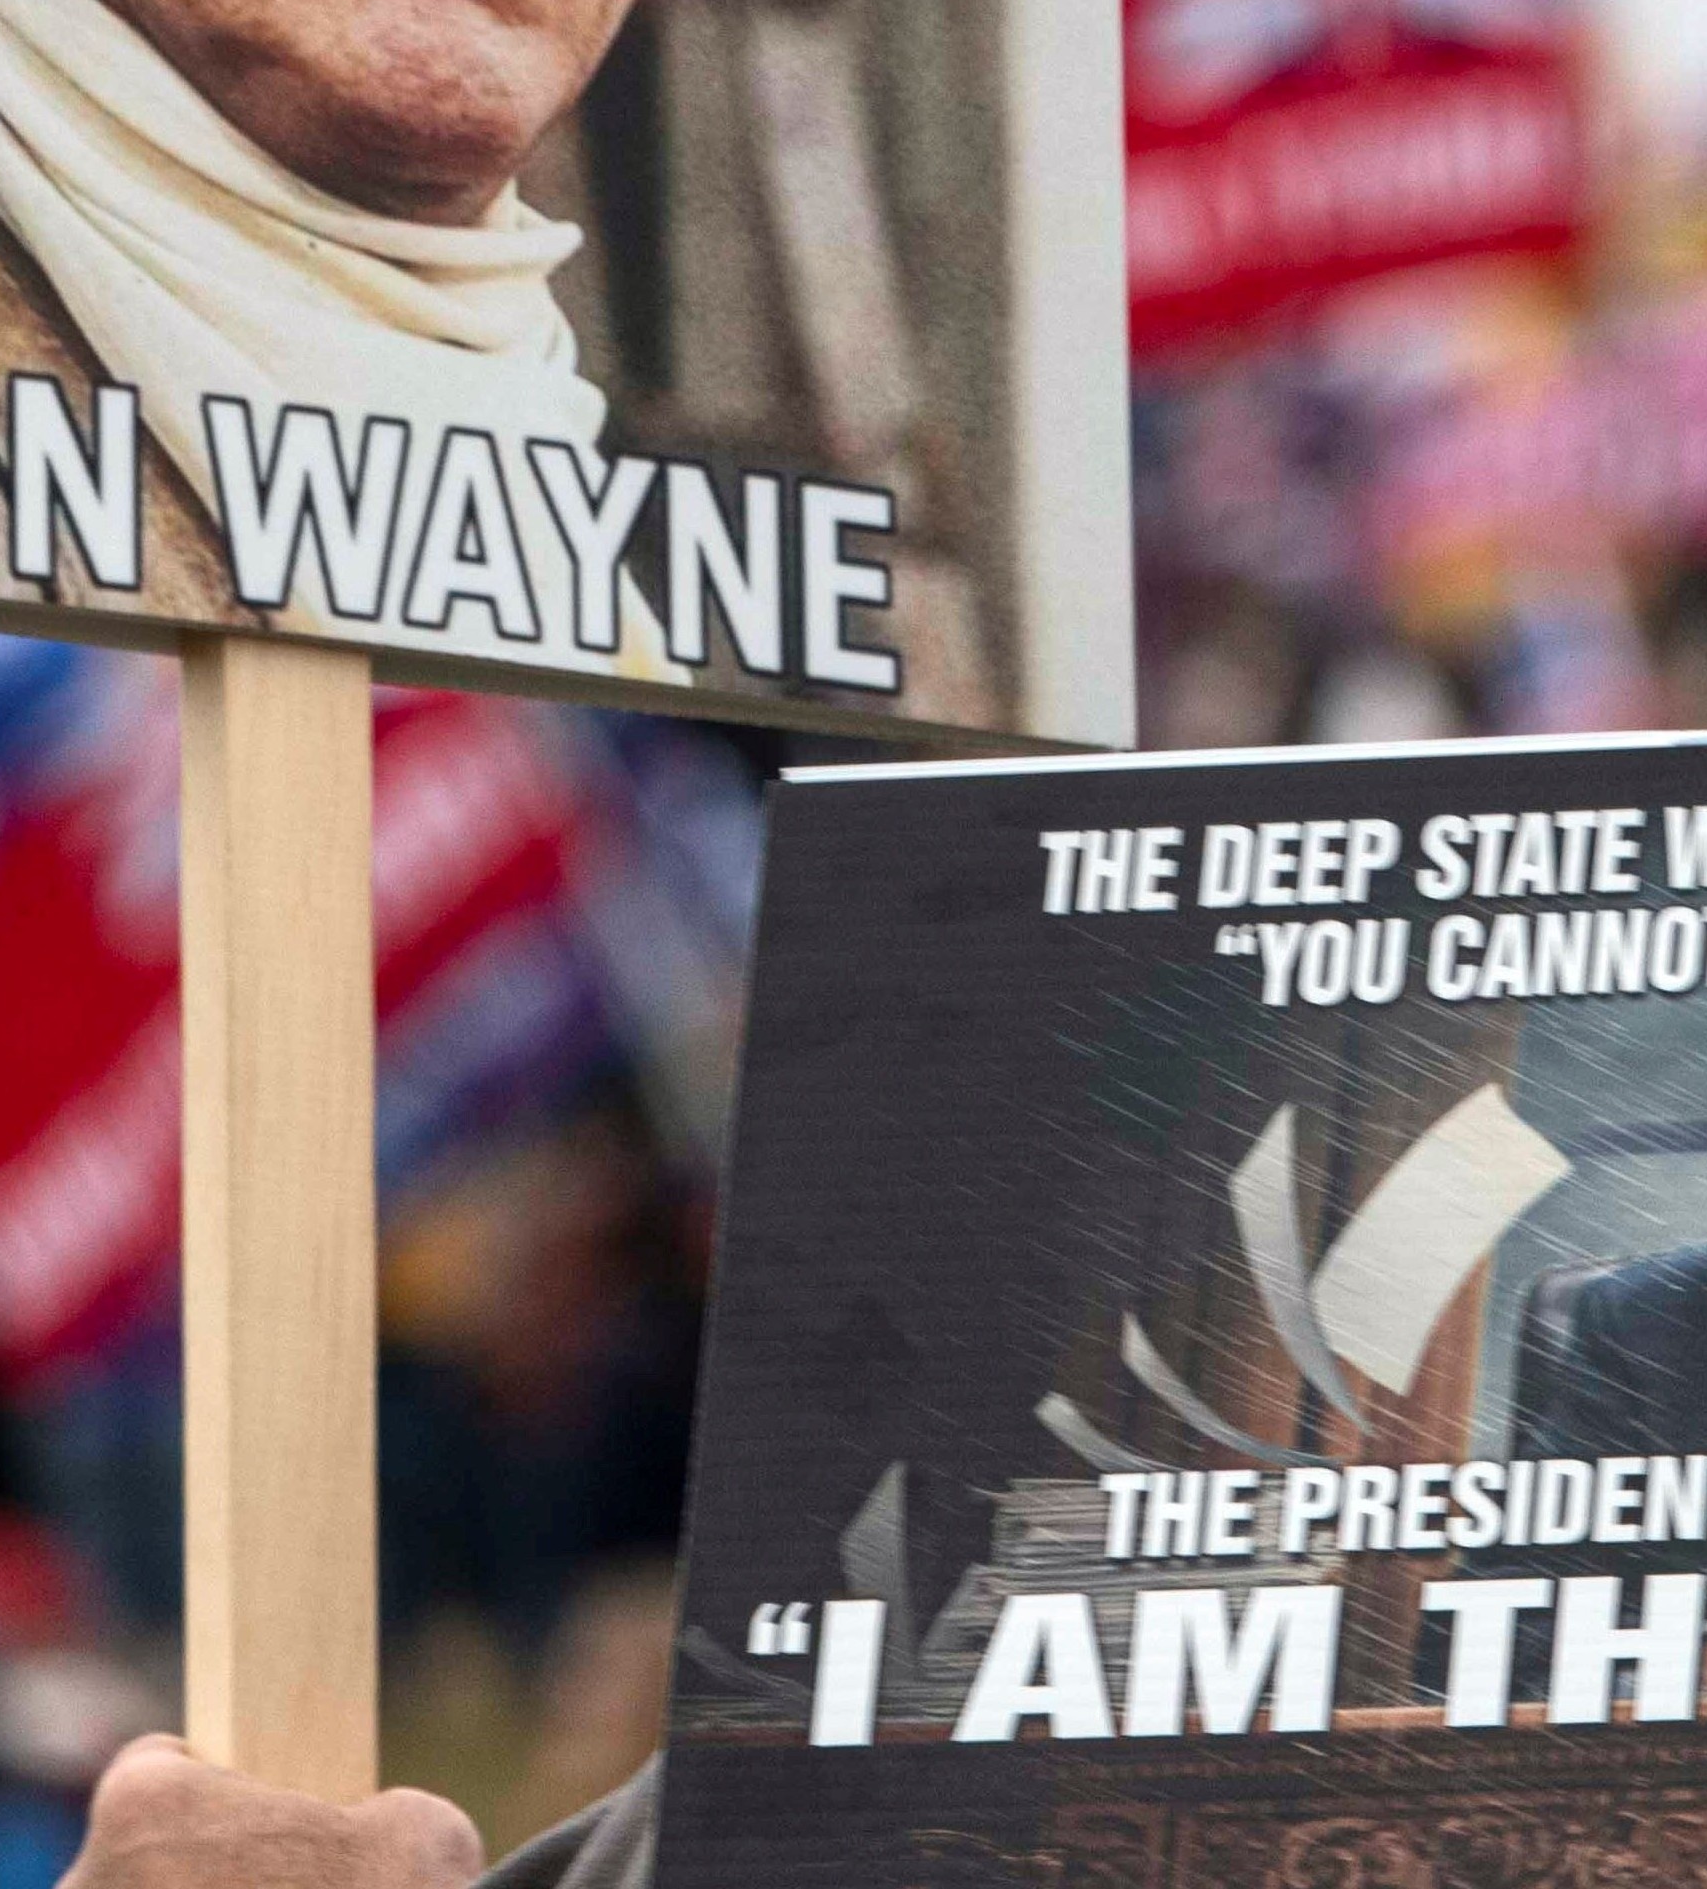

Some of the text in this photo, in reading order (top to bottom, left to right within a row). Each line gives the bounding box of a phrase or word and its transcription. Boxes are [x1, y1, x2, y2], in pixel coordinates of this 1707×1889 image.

[201, 392, 901, 694] WAYNE
[1039, 826, 1184, 914] THE
[1197, 817, 1401, 909] DEEP
[1415, 808, 1647, 900] STATE
[1214, 918, 1411, 1006] “YOU
[1100, 1469, 1262, 1559] THE
[746, 1598, 888, 1747] “I
[949, 1585, 1343, 1744] AM
